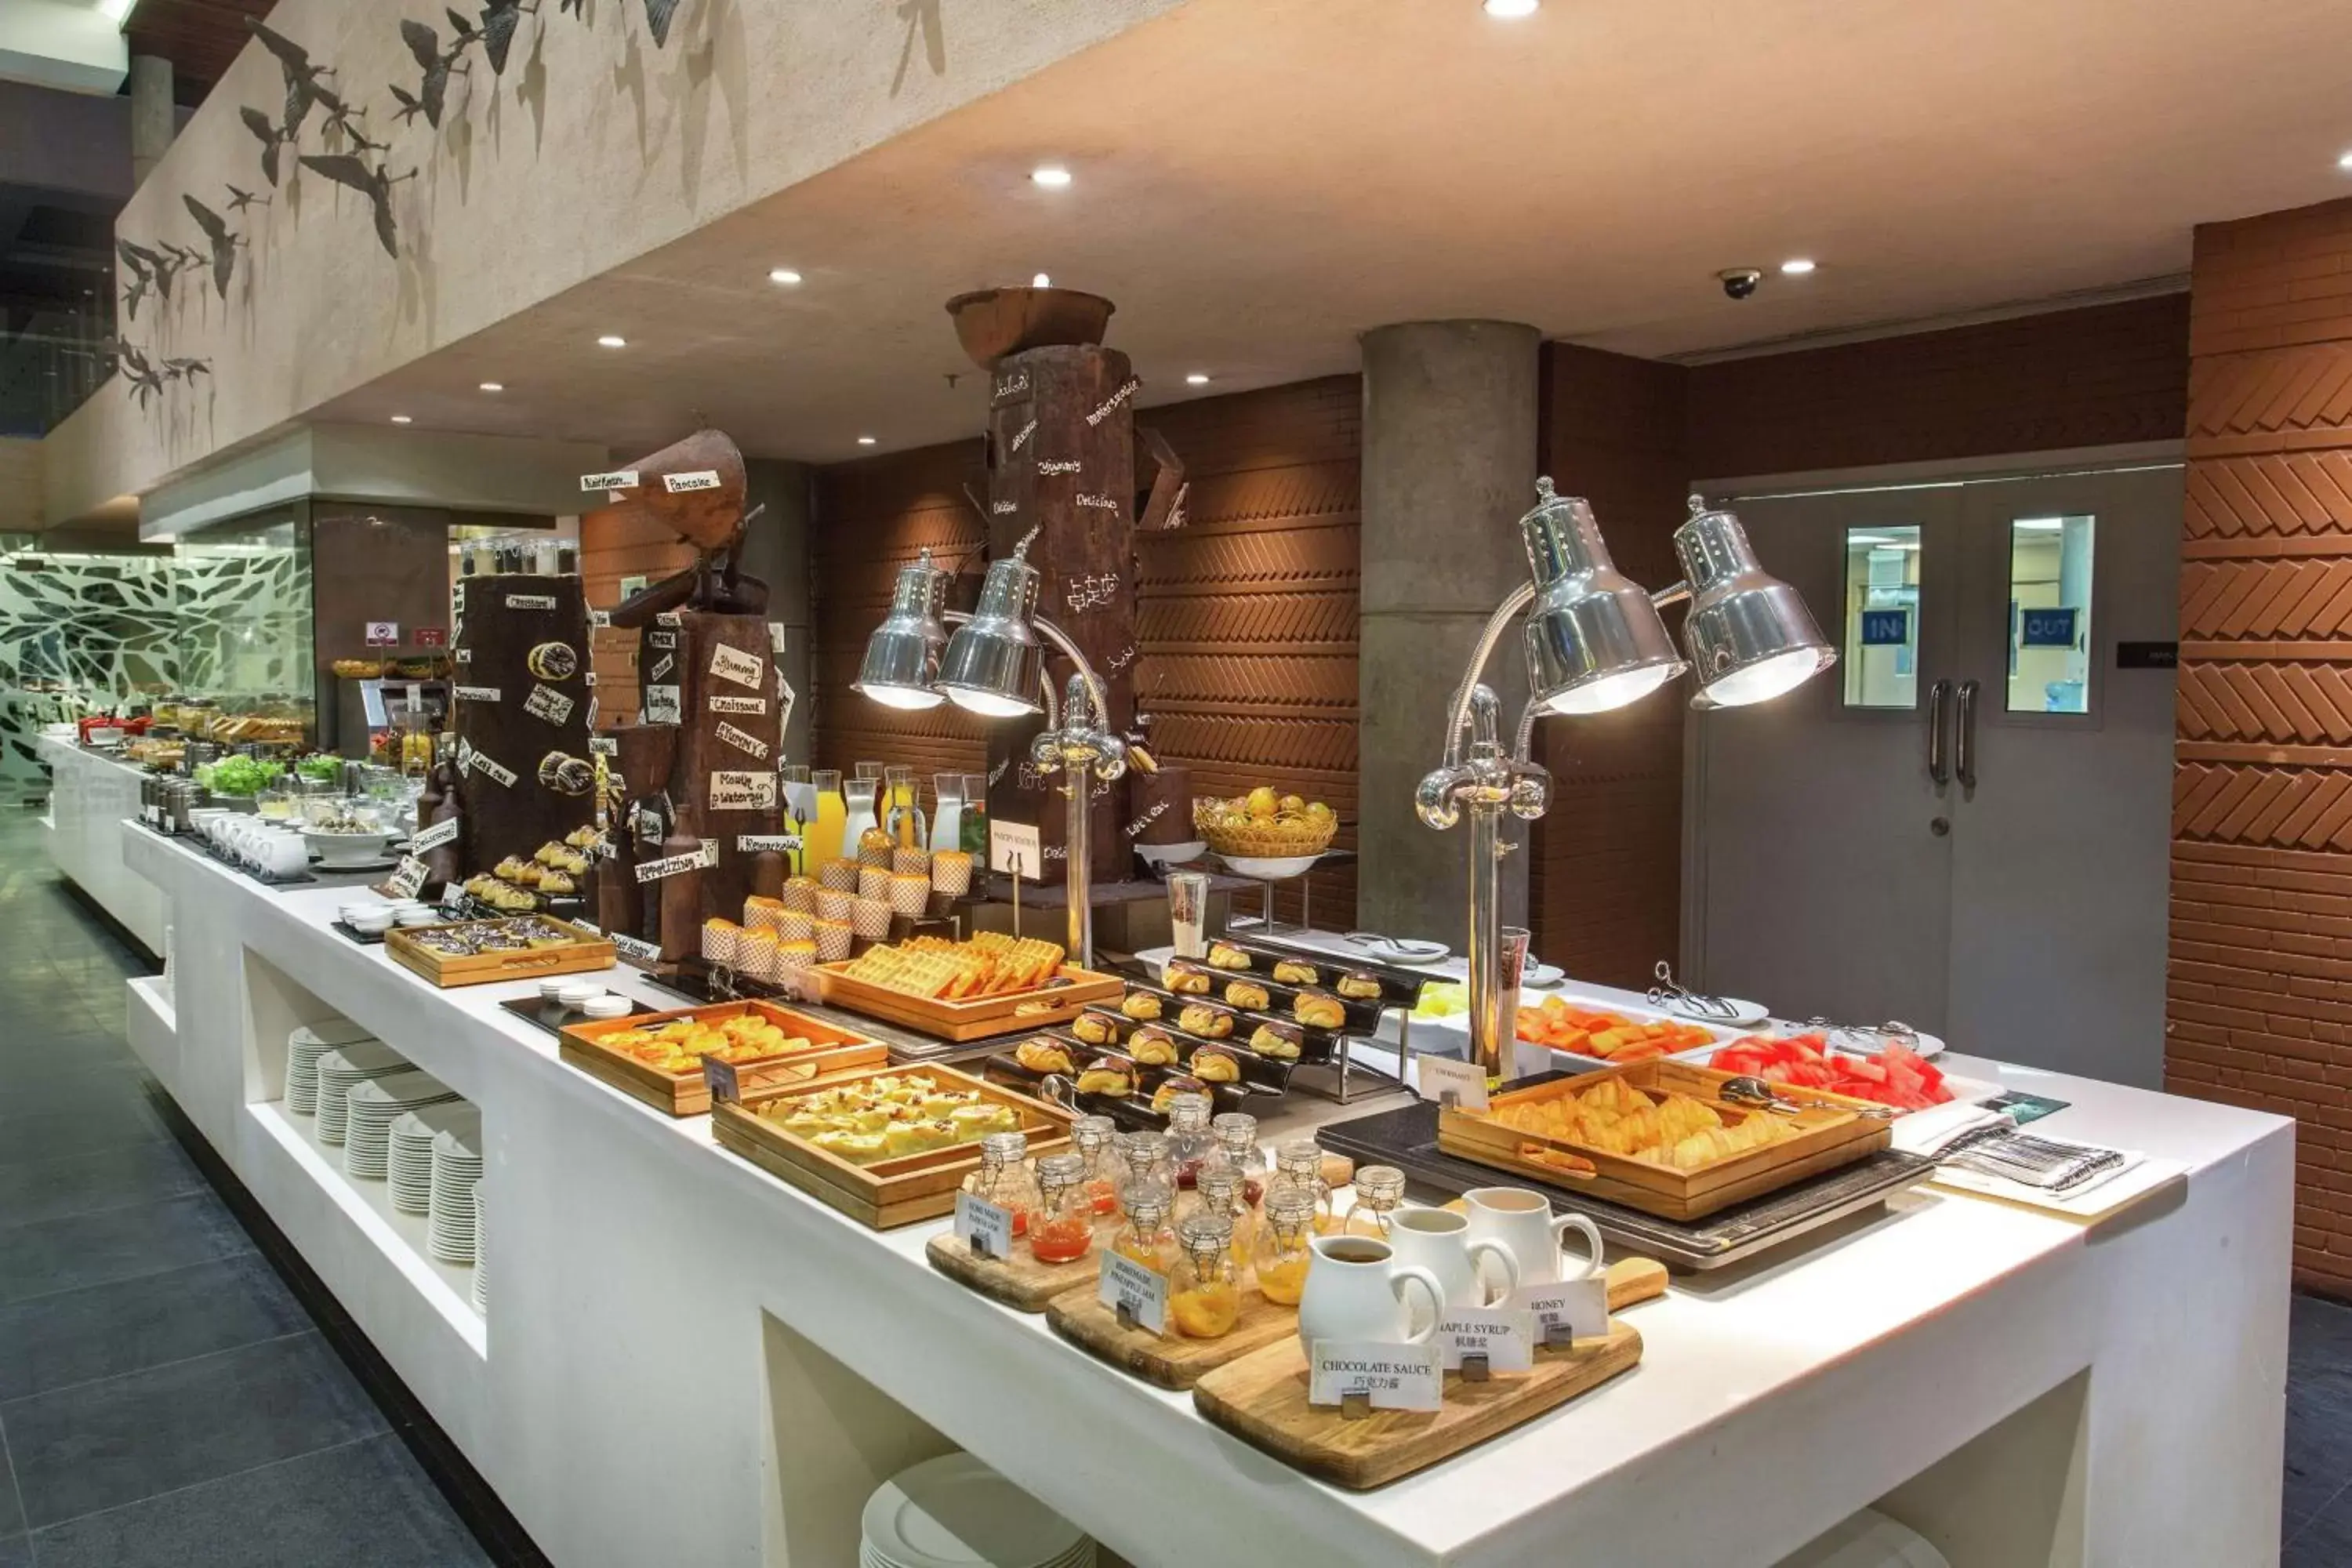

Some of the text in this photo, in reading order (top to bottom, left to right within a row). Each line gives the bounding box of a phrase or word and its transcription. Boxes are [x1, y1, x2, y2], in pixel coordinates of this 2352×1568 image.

[1871, 618, 1899, 637] IN
[2028, 619, 2070, 636] OUT
[1474, 1323, 1511, 1335] SYRUP
[1323, 1360, 1431, 1375] CHOCOLATE SAUCE
